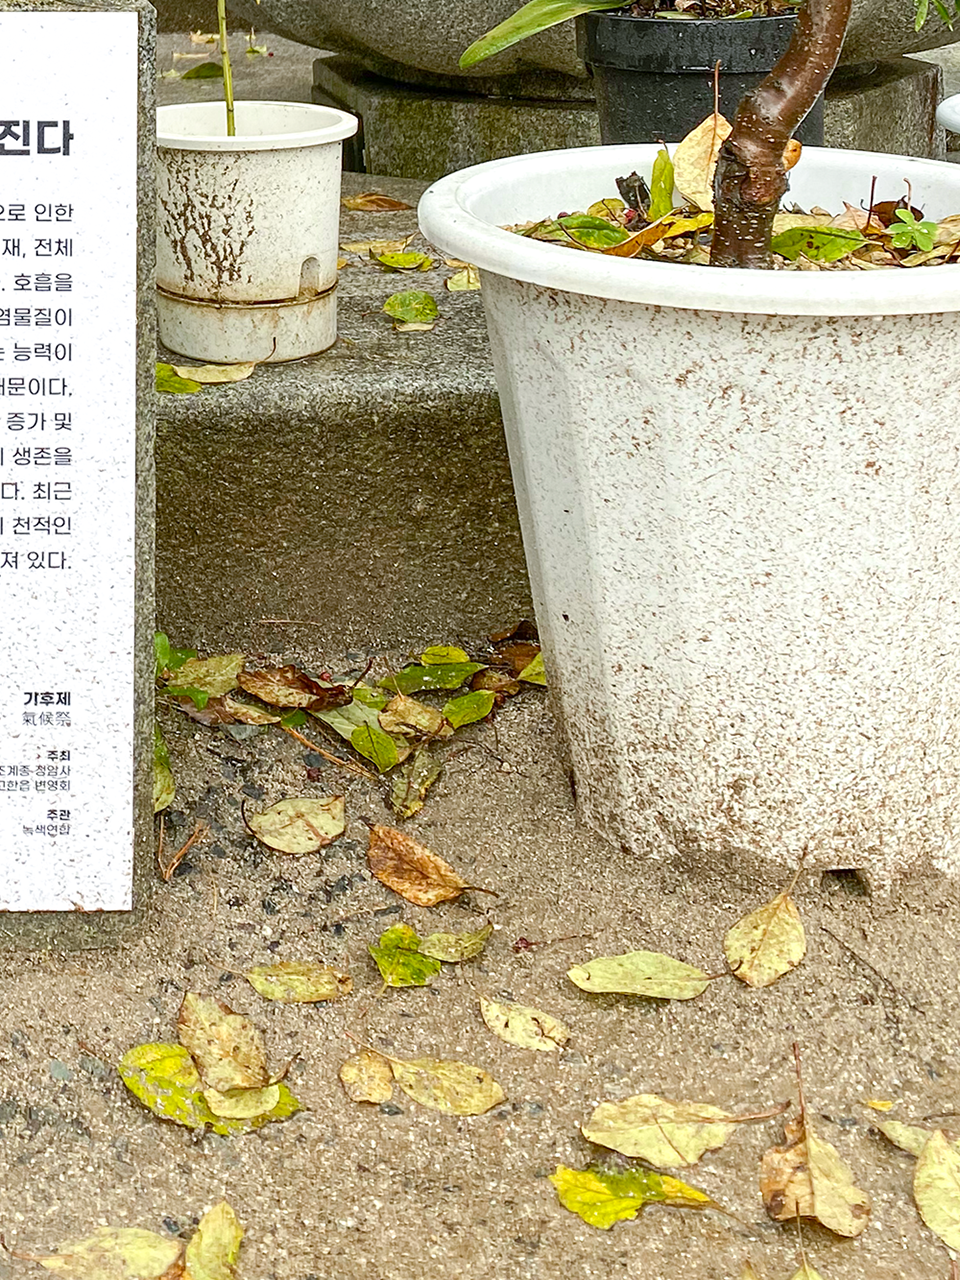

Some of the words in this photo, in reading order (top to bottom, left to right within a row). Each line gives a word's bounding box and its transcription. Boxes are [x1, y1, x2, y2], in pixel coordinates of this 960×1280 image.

[34, 203, 75, 222] 인한
[34, 238, 73, 257] 전체
[13, 272, 73, 292] 호흡을
[13, 342, 72, 362] 능력이
[6, 412, 47, 432] 증가
[54, 412, 72, 431] 및
[12, 446, 73, 466] 생존을
[32, 481, 73, 501] 최근
[12, 515, 72, 536] 천적인
[26, 551, 72, 570] 있다.
[46, 750, 72, 761] 주최
[46, 809, 72, 821] 주관
